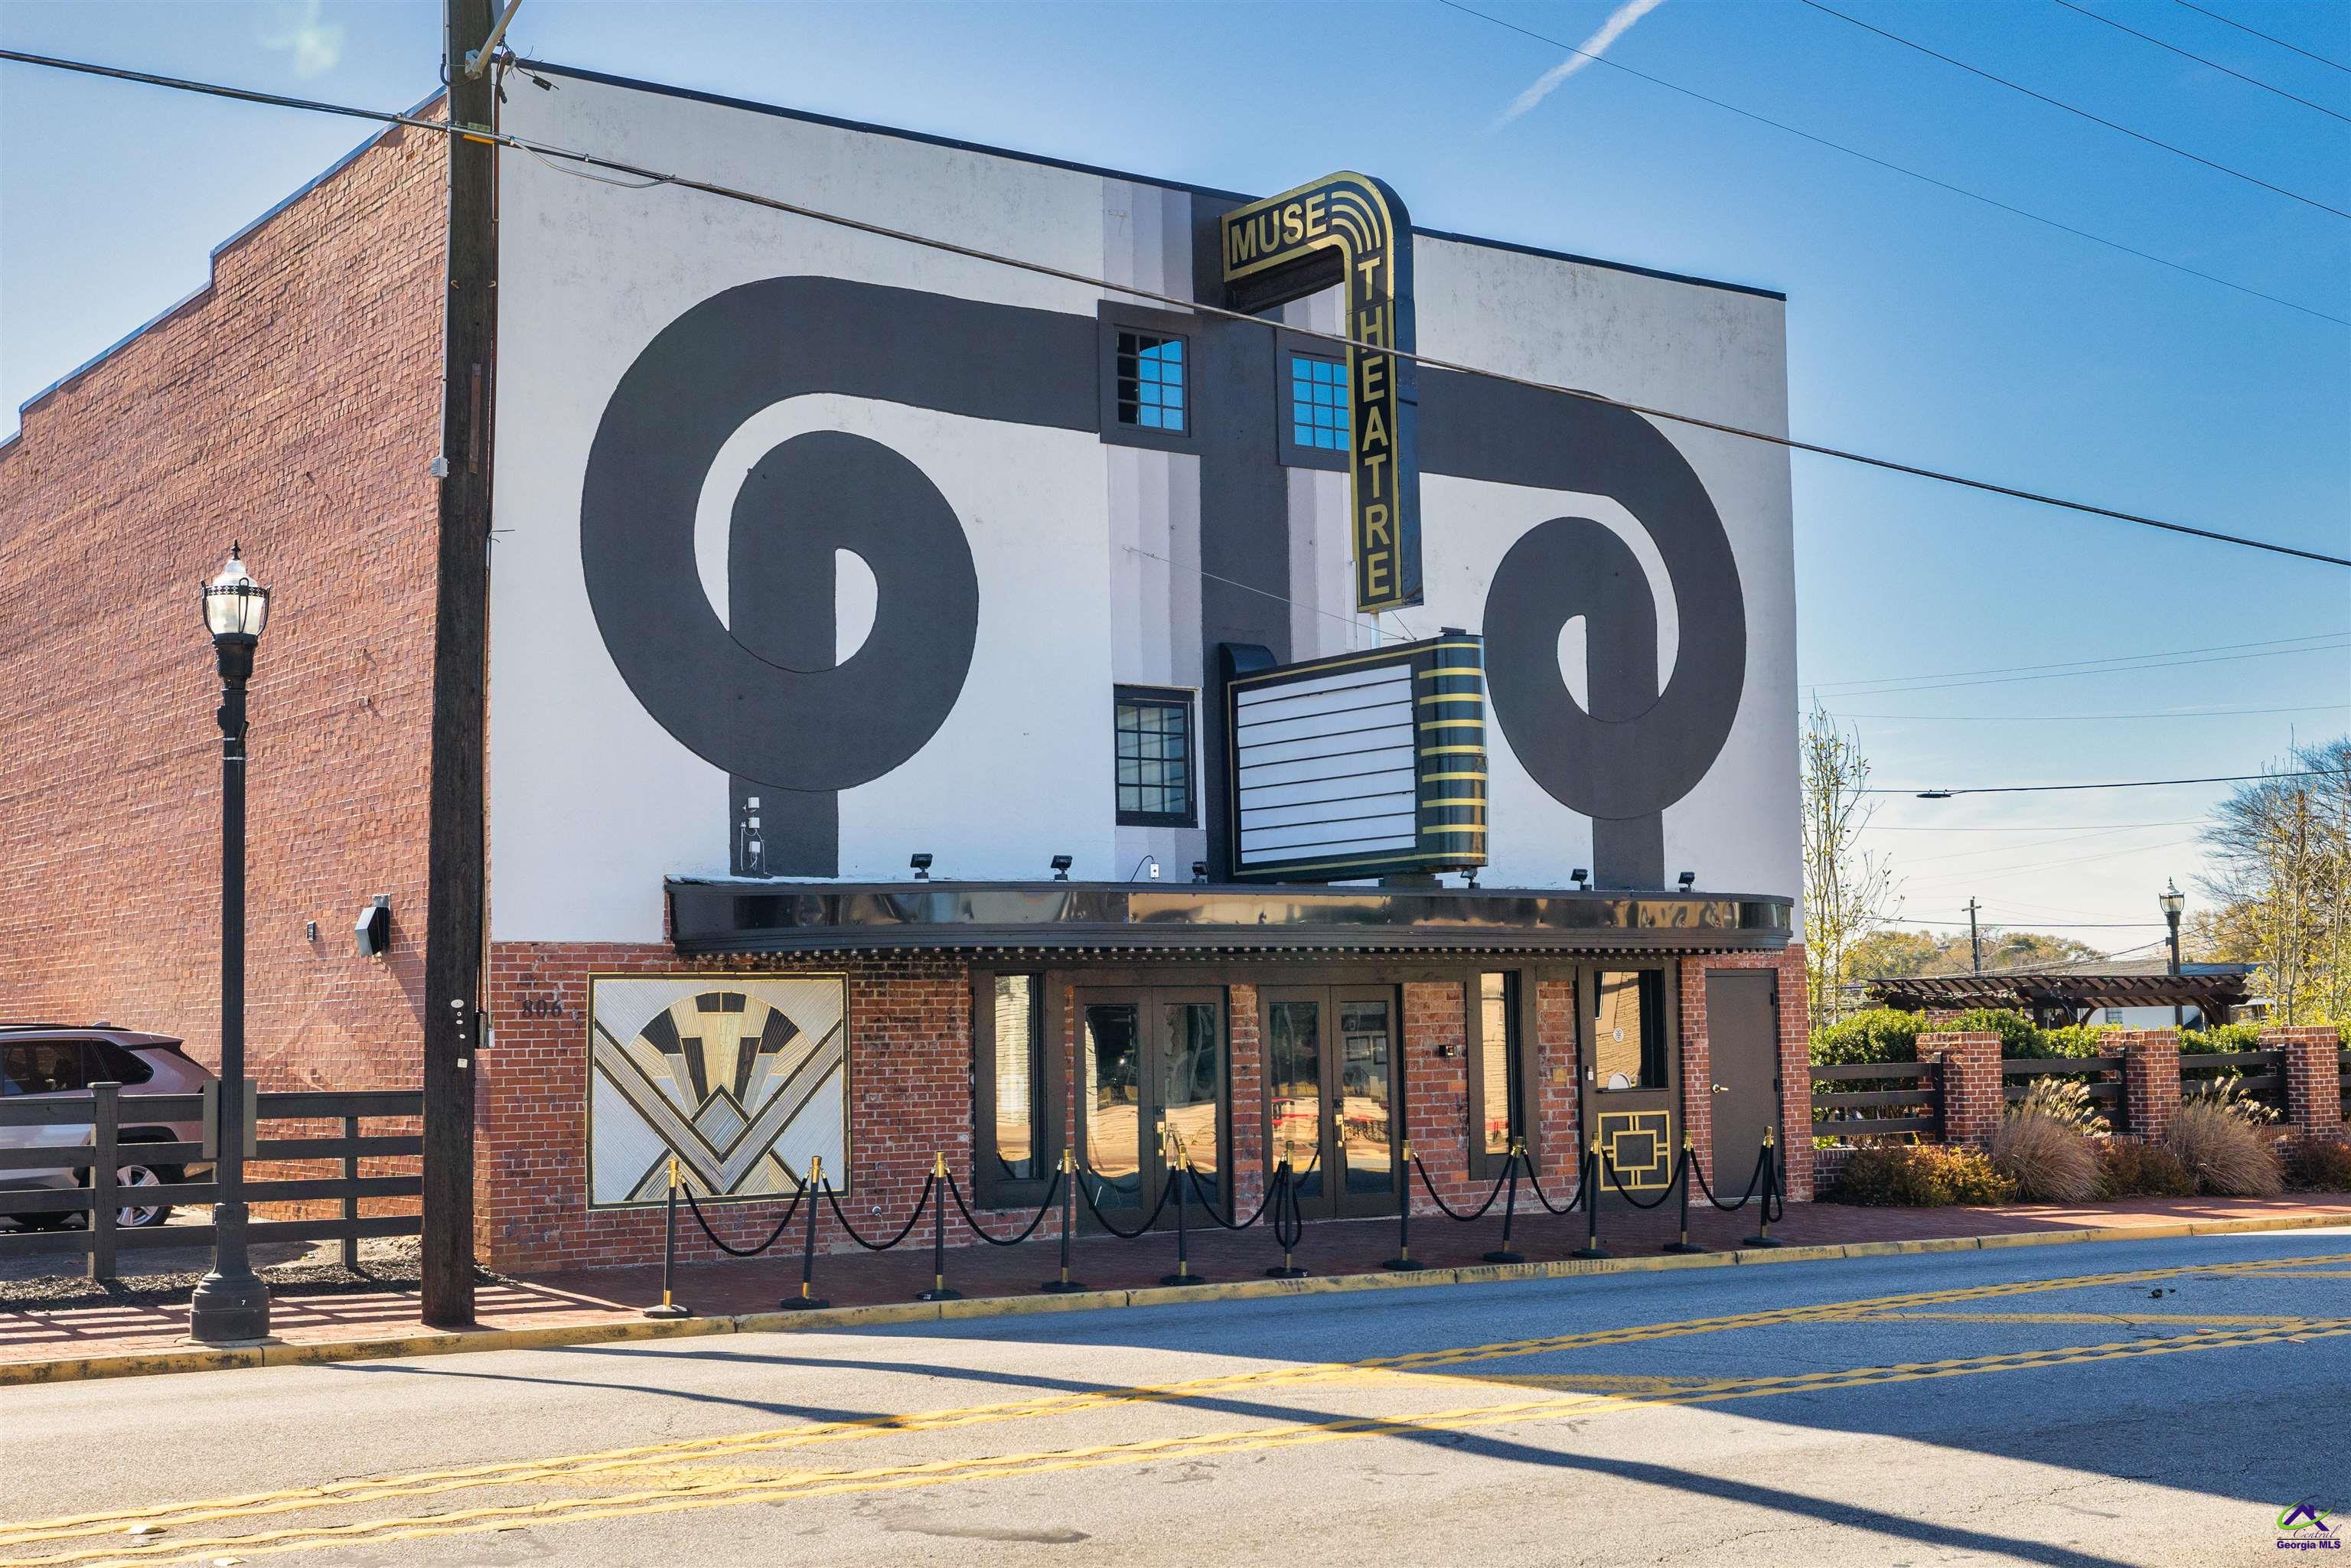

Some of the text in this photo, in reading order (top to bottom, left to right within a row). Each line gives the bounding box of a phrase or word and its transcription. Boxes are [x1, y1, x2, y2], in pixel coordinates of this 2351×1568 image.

[1230, 192, 1329, 264] MUSE
[1357, 256, 1391, 598] THEATRE
[522, 999, 562, 1017] 806
